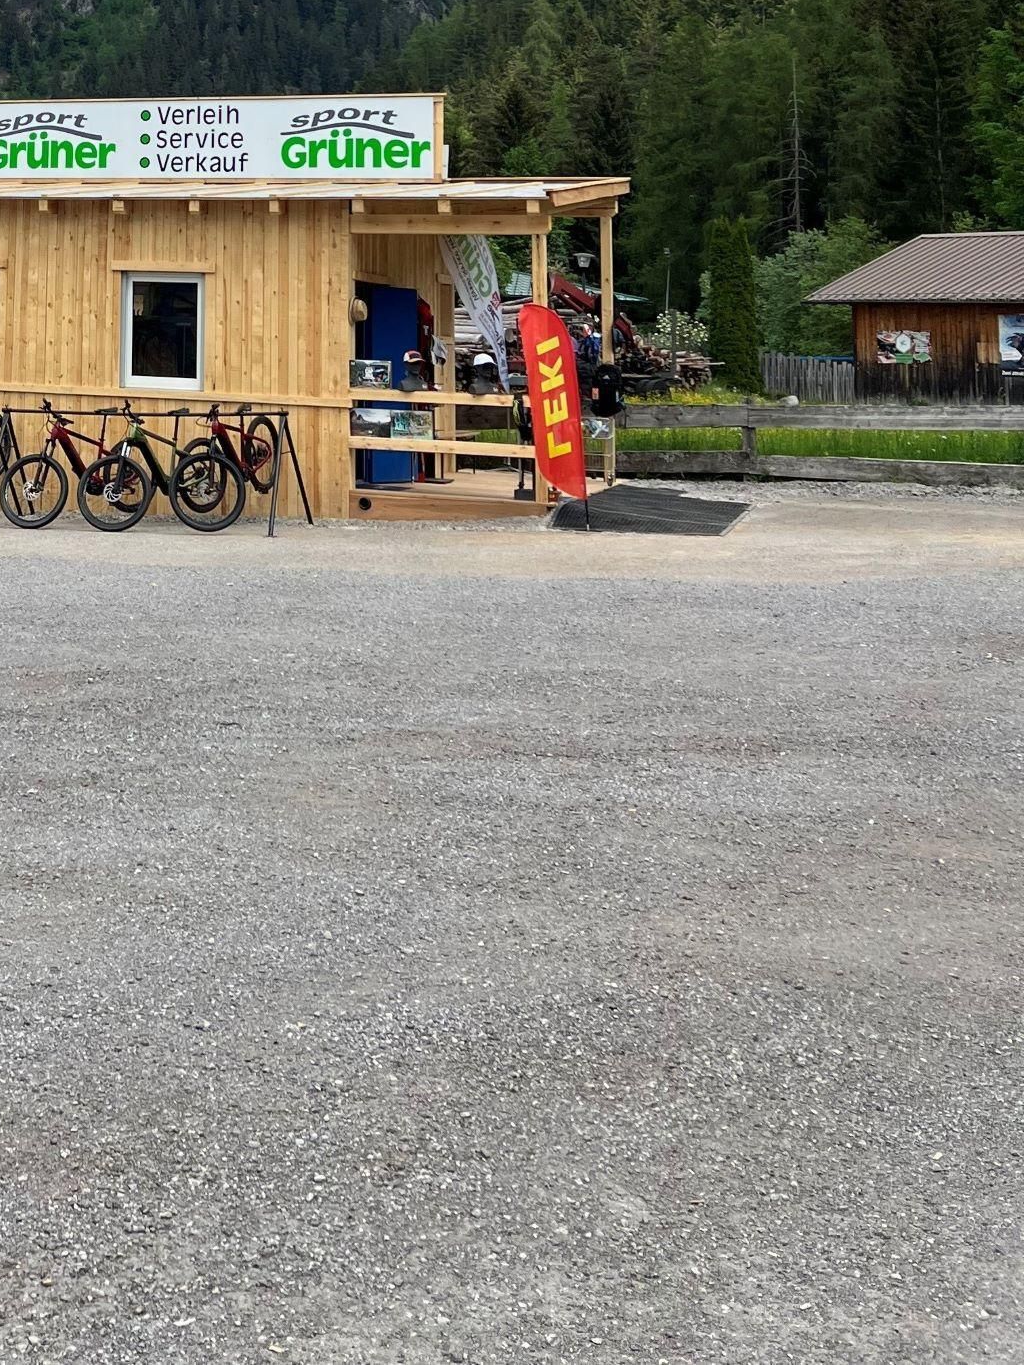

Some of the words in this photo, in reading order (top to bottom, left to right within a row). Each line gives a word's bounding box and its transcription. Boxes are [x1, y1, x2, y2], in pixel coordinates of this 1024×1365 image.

[157, 105, 240, 125] Verleih
[291, 107, 398, 128] sport
[156, 129, 244, 149] Service
[280, 128, 431, 169] Grüner
[157, 152, 249, 172] Verkauf
[536, 335, 573, 459] LEKI
